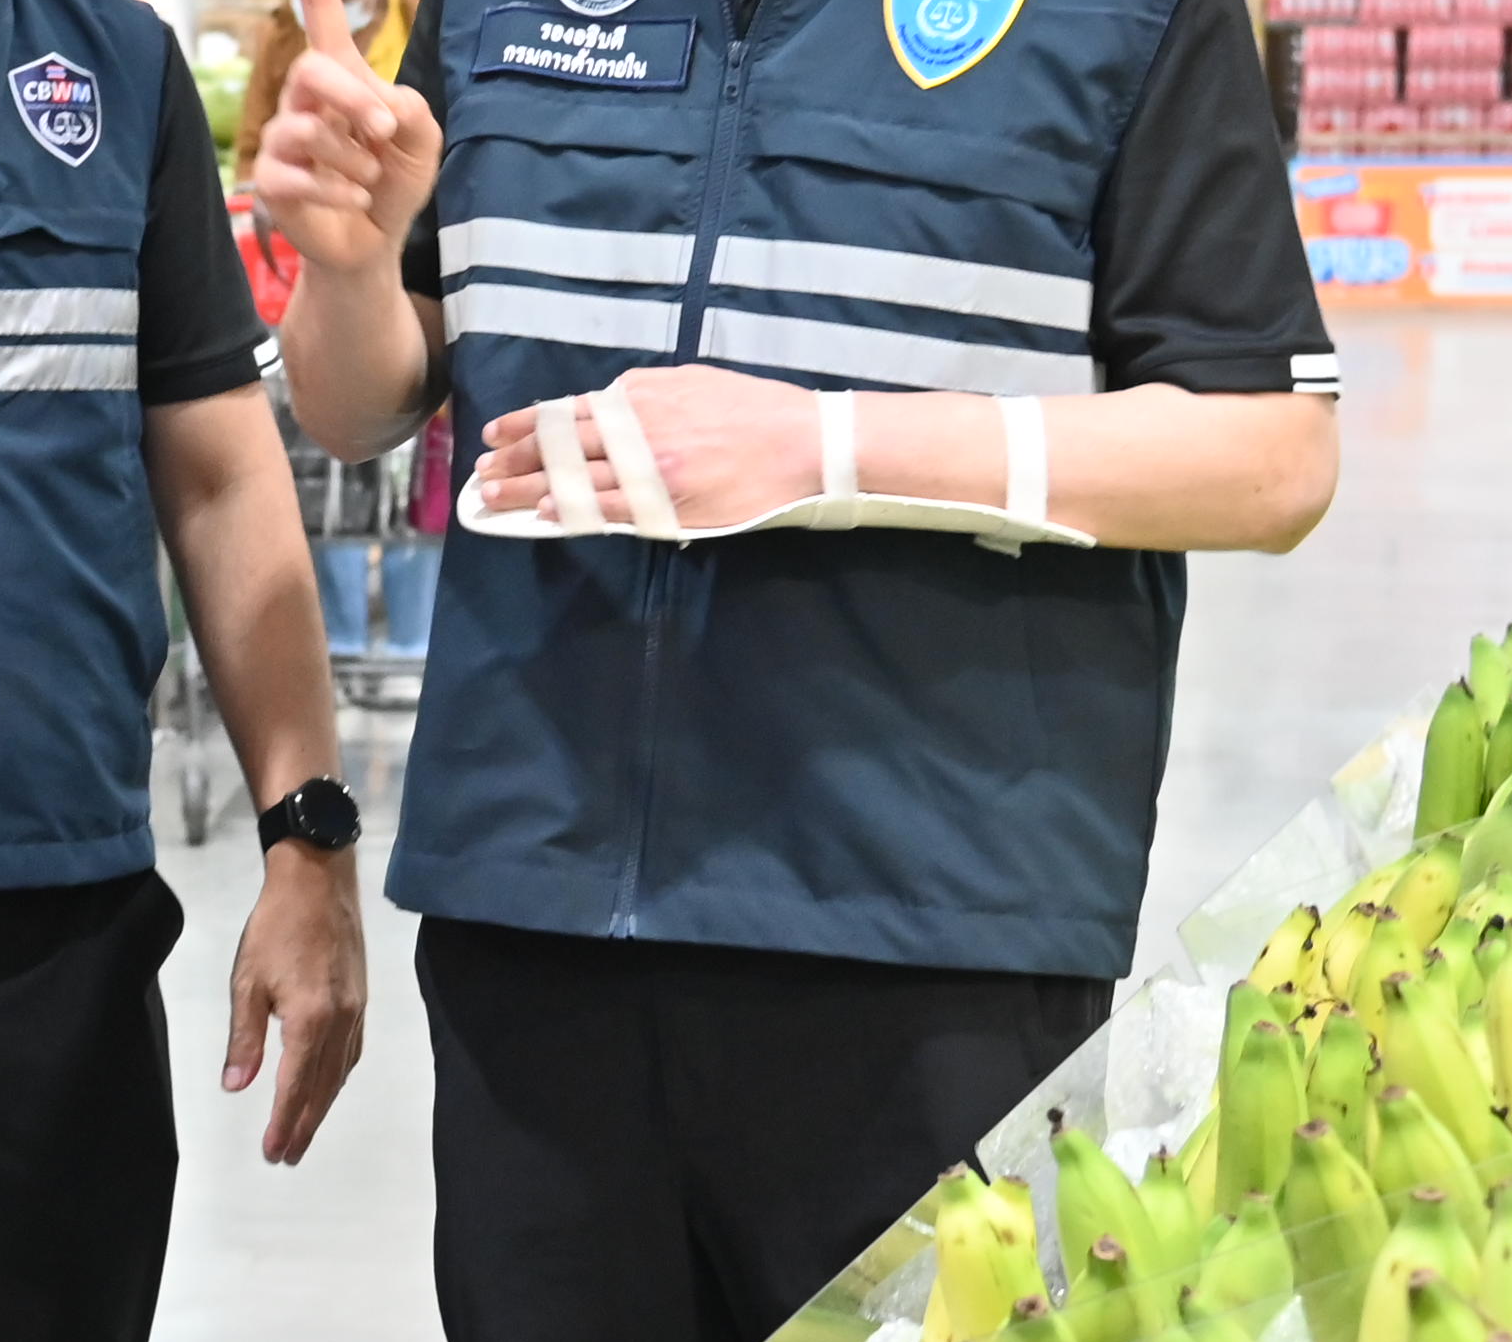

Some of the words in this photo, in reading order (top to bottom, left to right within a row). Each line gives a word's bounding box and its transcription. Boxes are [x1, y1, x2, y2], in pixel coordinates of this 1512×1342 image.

[540, 22, 627, 51] รองอธิบดี
[503, 43, 647, 80] กรมการค้าภายใน
[23, 81, 91, 103] CBWM
